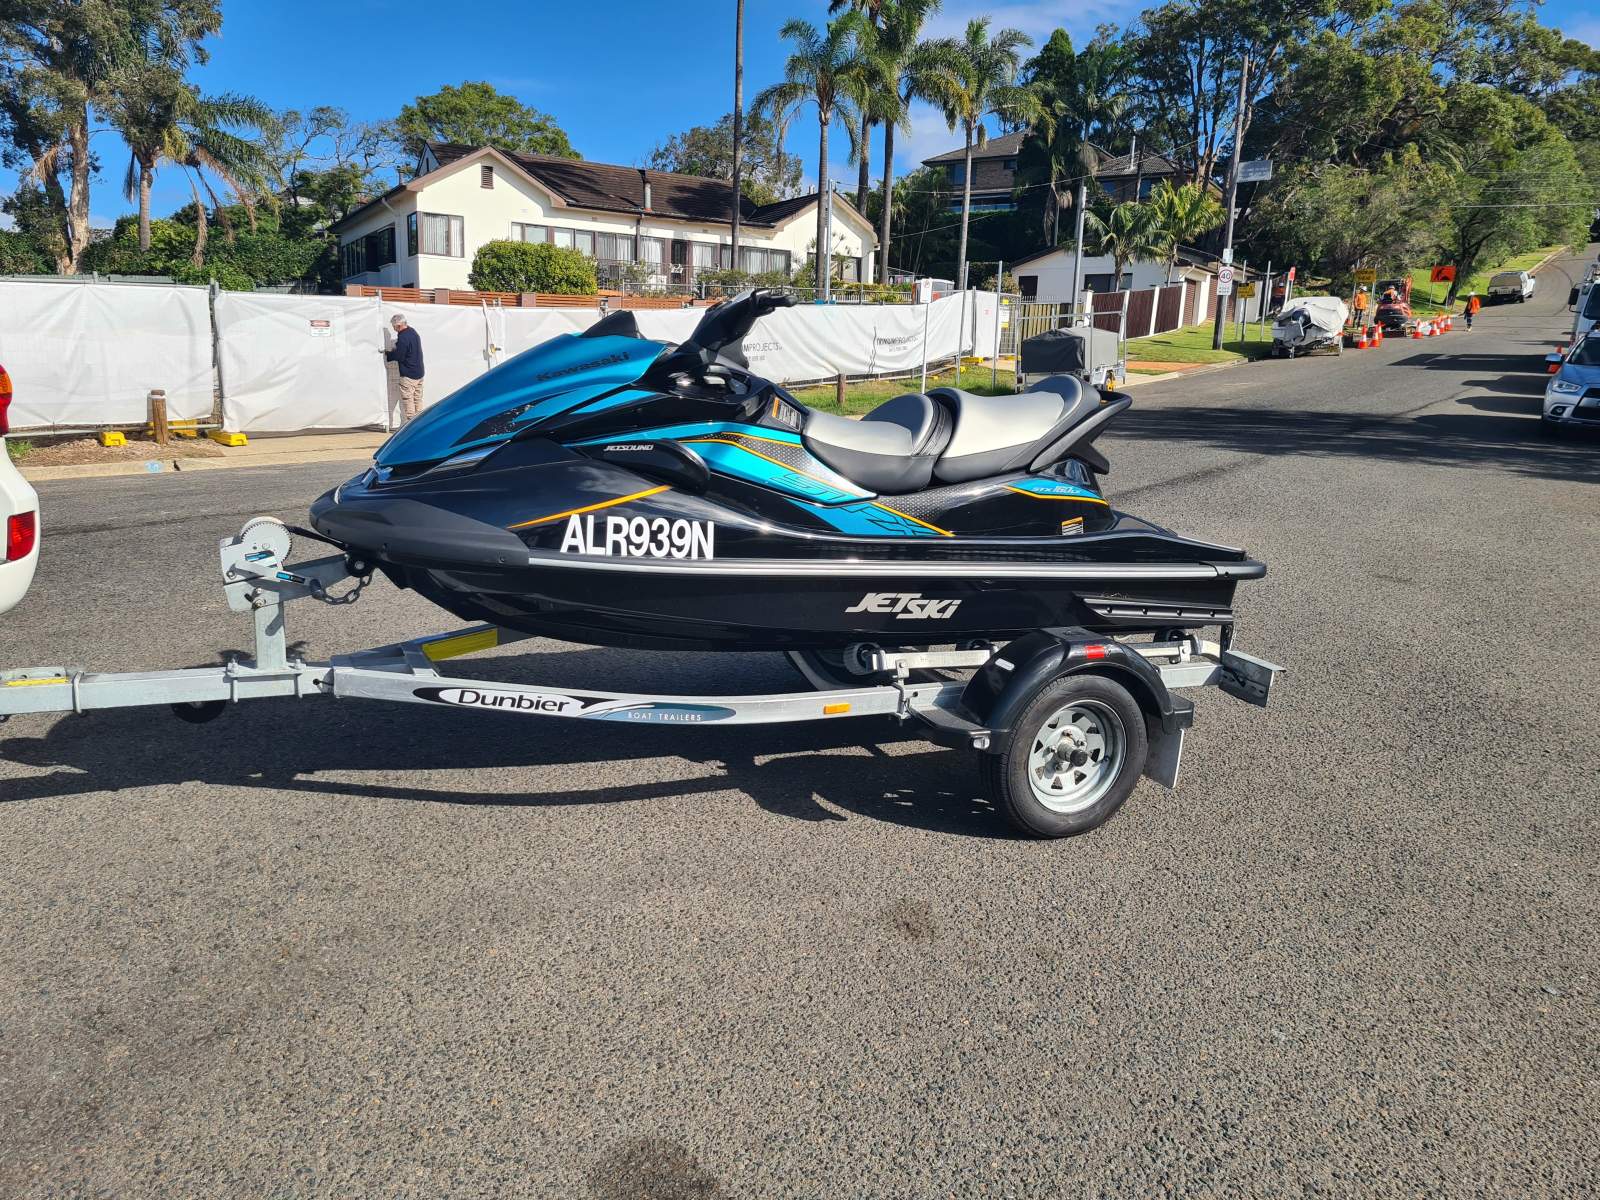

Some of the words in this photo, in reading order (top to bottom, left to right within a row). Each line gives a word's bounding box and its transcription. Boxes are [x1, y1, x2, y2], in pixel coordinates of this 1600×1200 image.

[1221, 272, 1231, 280] 40
[536, 351, 630, 381] Kawasaki
[559, 513, 715, 560] ALR939N
[458, 689, 571, 712] Dunbier
[627, 711, 652, 719] BOAT
